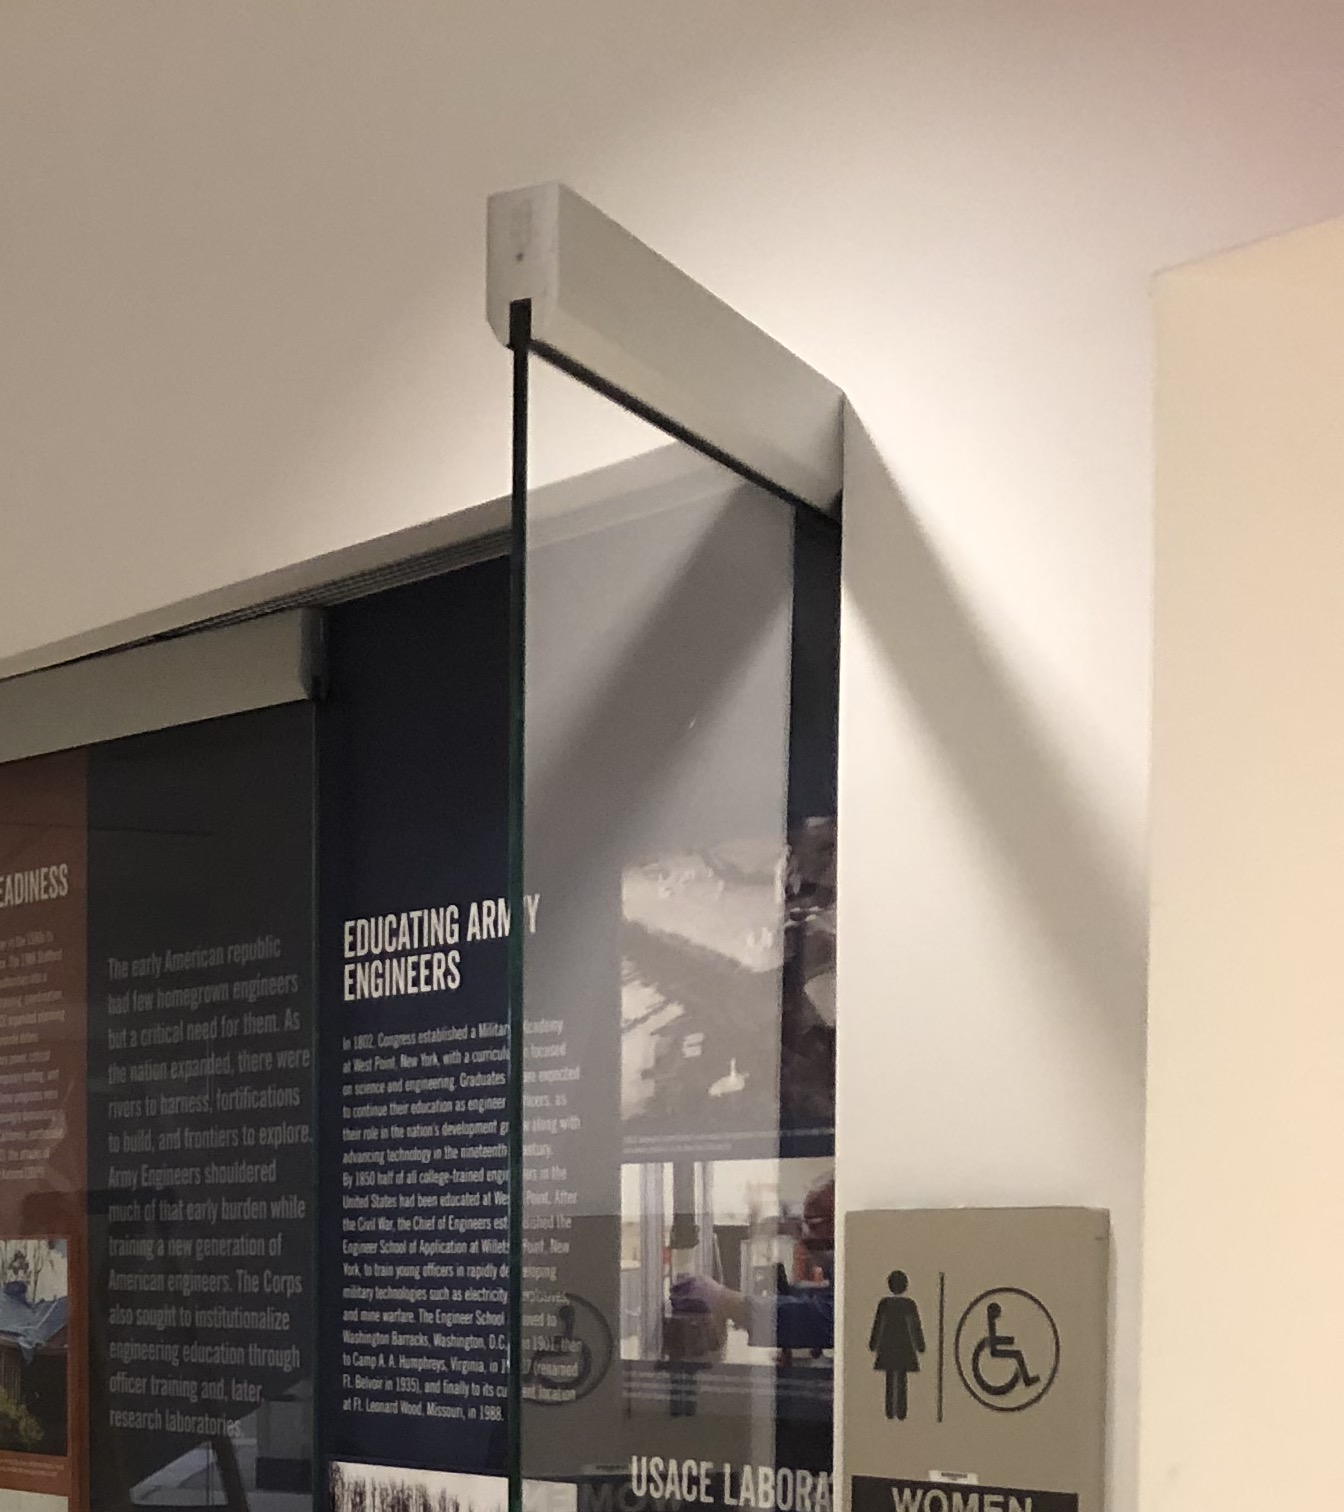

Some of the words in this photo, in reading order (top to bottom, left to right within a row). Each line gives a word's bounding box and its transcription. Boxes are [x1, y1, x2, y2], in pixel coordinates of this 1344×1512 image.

[344, 904, 459, 958] EDUCATING
[109, 958, 128, 979] The
[132, 954, 161, 977] early
[164, 946, 223, 971] American
[227, 935, 281, 967] republic
[344, 950, 461, 1000] ENGINEERS
[108, 994, 129, 1014] had
[133, 990, 153, 1011] few
[157, 983, 229, 1010] homegrown
[233, 974, 298, 1002] engineers
[108, 1028, 127, 1049] but
[130, 1032, 137, 1047] a
[141, 1020, 183, 1046] critical
[187, 1016, 217, 1040] need
[221, 1014, 240, 1037] for
[244, 1011, 280, 1034] them.
[284, 1008, 300, 1031] As
[108, 1063, 126, 1084] the
[130, 1059, 166, 1081] nation
[171, 1053, 234, 1082] expanded,
[239, 1051, 272, 1072] there
[277, 1048, 310, 1068] were
[460, 1072, 505, 1087] Graduates
[108, 1098, 141, 1118] rivers
[146, 1096, 156, 1116] to
[161, 1093, 212, 1115] harness,
[217, 1087, 300, 1111] fortifications
[109, 1132, 120, 1153] to
[123, 1129, 155, 1152] build,
[159, 1129, 181, 1149] and
[185, 1126, 239, 1148] frontiers
[243, 1125, 255, 1145] to
[259, 1121, 312, 1148] explore.
[108, 1167, 138, 1190] Army
[142, 1164, 201, 1190] Engineers
[205, 1160, 277, 1184] shouldered
[109, 1202, 140, 1222] much
[144, 1200, 156, 1221] of
[160, 1200, 183, 1220] that
[187, 1199, 217, 1224] early
[222, 1198, 266, 1220] burden
[271, 1195, 305, 1219] while
[343, 1217, 356, 1231] the
[358, 1214, 375, 1230] Civil
[378, 1215, 395, 1232] War,
[398, 1214, 410, 1230] the
[413, 1213, 435, 1230] Chief
[438, 1214, 446, 1230] of
[449, 1213, 491, 1232] Engineers
[109, 1234, 154, 1260] training
[157, 1238, 164, 1256] a
[168, 1239, 192, 1256] new
[196, 1234, 265, 1260] generation
[269, 1233, 282, 1256] of
[343, 1238, 377, 1256] Engineer
[380, 1239, 406, 1254] School
[409, 1239, 417, 1254] of
[419, 1239, 466, 1257] Application
[469, 1241, 479, 1253] at
[108, 1269, 163, 1292] American
[168, 1270, 232, 1296] engineers.
[237, 1269, 259, 1293] The
[264, 1269, 302, 1298] Corps
[343, 1263, 361, 1278] York,
[364, 1264, 372, 1276] to
[374, 1262, 393, 1277] train
[396, 1264, 420, 1280] young
[423, 1261, 453, 1277] officers
[457, 1262, 464, 1277] in
[467, 1261, 497, 1281] rapidly
[109, 1303, 133, 1326] also
[137, 1305, 176, 1330] sought
[180, 1307, 192, 1327] to
[195, 1305, 290, 1330] institutionalize
[343, 1309, 358, 1321] and
[383, 1309, 415, 1323] warfare.
[419, 1308, 433, 1323] The
[436, 1308, 473, 1327] Engineer
[476, 1310, 504, 1326] School
[109, 1338, 179, 1366] engineering
[183, 1341, 244, 1365] education
[249, 1344, 300, 1372] through
[109, 1371, 147, 1394] officer
[151, 1374, 197, 1403] training
[343, 1375, 353, 1388] Ft.
[385, 1377, 393, 1391] in
[424, 1379, 440, 1394] and
[443, 1379, 469, 1399] finally
[472, 1382, 481, 1396] to
[483, 1381, 494, 1397] its
[109, 1408, 162, 1430] research
[343, 1399, 351, 1410] at
[353, 1398, 363, 1411] Ft.
[366, 1399, 398, 1414] Leonard
[468, 1405, 476, 1419] in
[480, 1404, 504, 1421] 1988.
[632, 1455, 714, 1503] USACE
